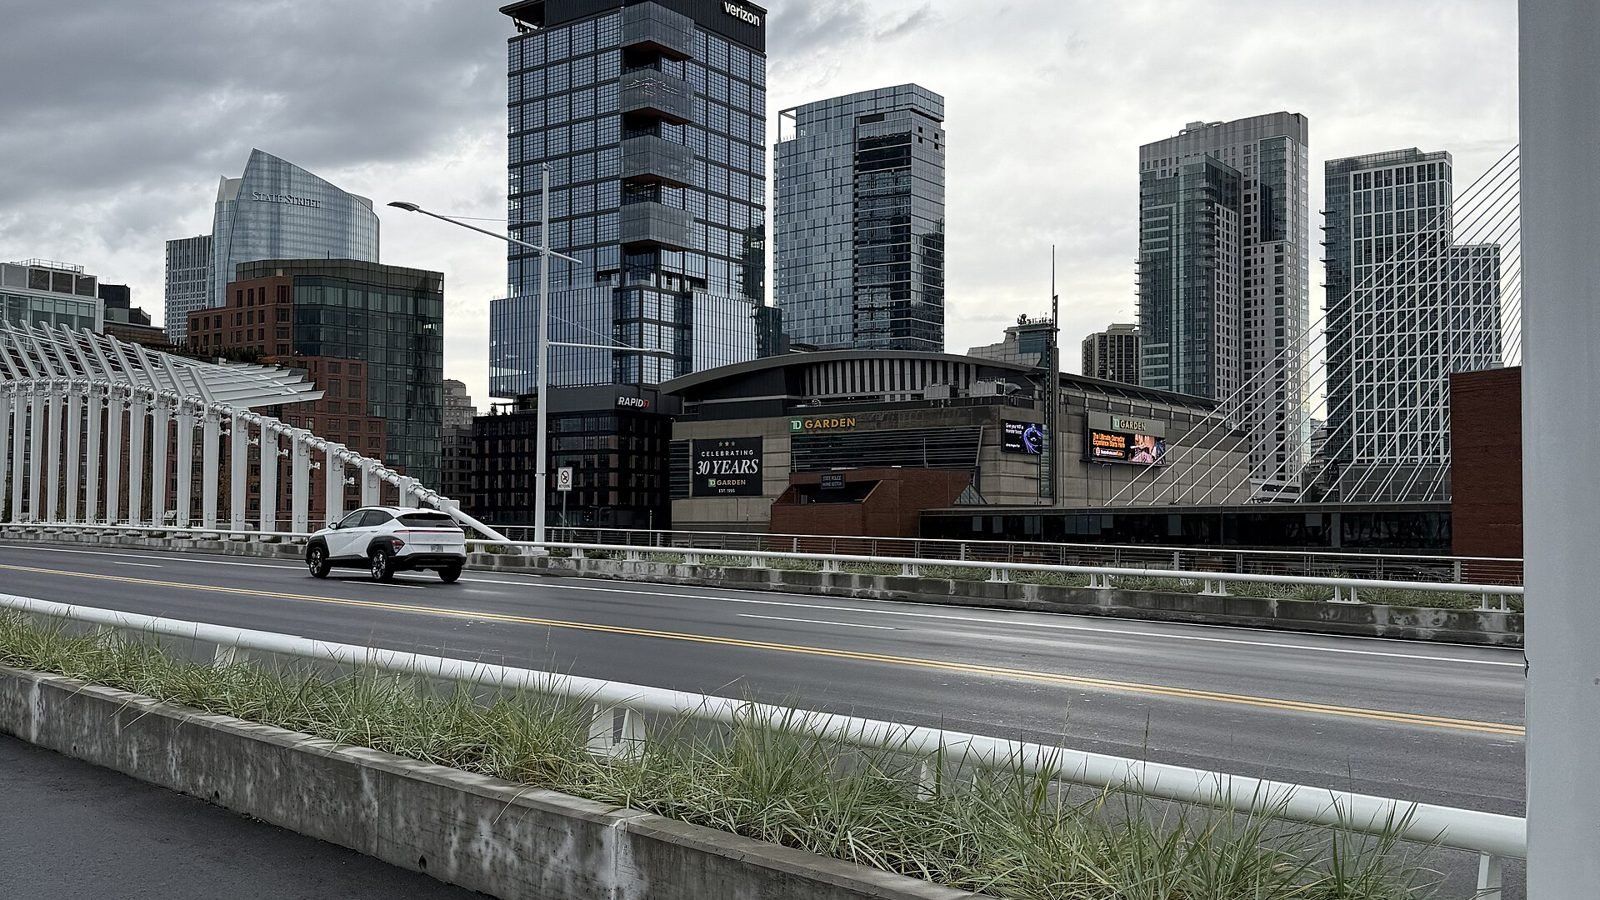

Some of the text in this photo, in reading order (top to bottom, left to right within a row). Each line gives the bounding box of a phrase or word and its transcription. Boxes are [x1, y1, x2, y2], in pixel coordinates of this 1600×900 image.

[724, 1, 760, 26] verizon
[252, 191, 321, 208] STATE STREET
[791, 418, 856, 430] TD GARDEN
[1120, 419, 1146, 431] GARDEN
[701, 449, 754, 457] CELEBRATING
[695, 458, 759, 475] 30 YEARS
